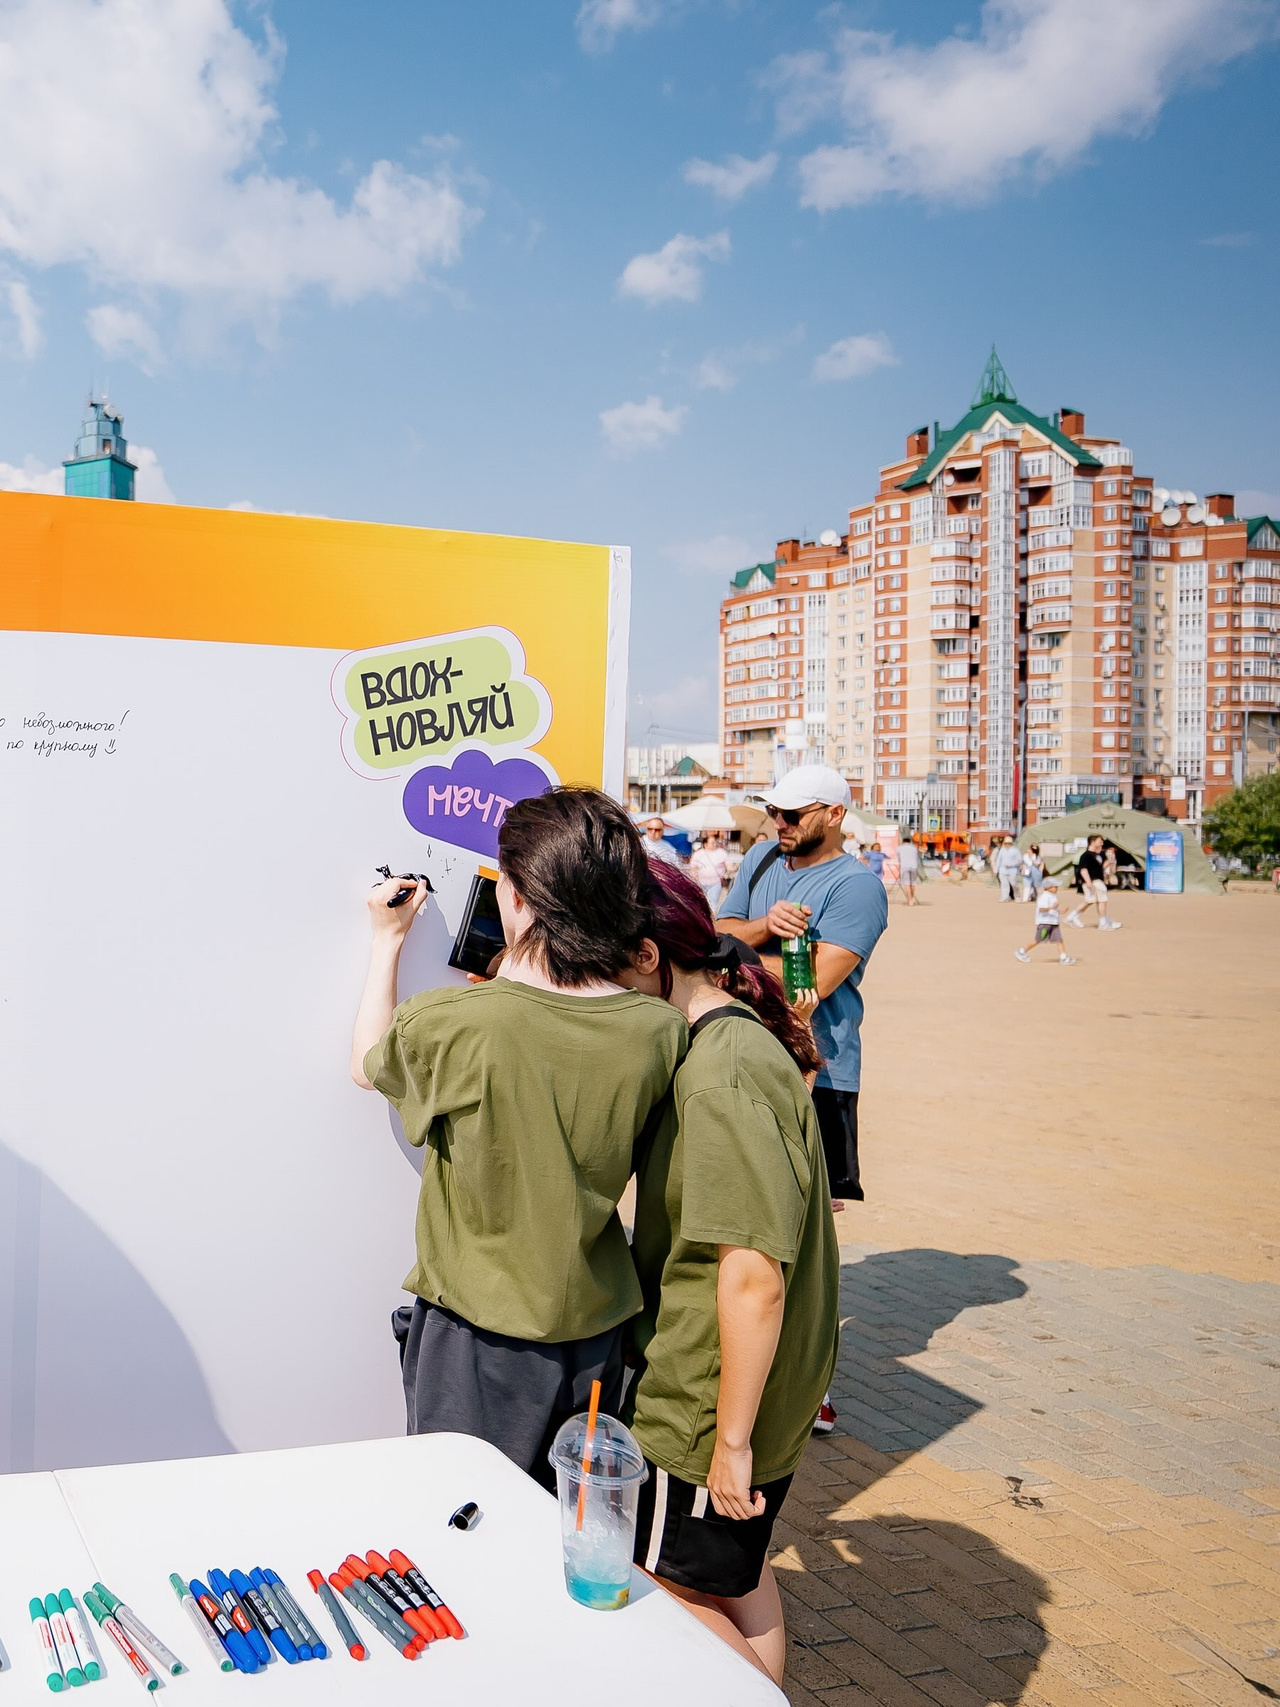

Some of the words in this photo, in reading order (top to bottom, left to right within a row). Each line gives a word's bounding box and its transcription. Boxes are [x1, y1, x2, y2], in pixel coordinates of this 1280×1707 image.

[369, 682, 515, 756] НОВЛЯЙ
[6, 740, 25, 750] по
[427, 784, 514, 827] МЕЧТ
